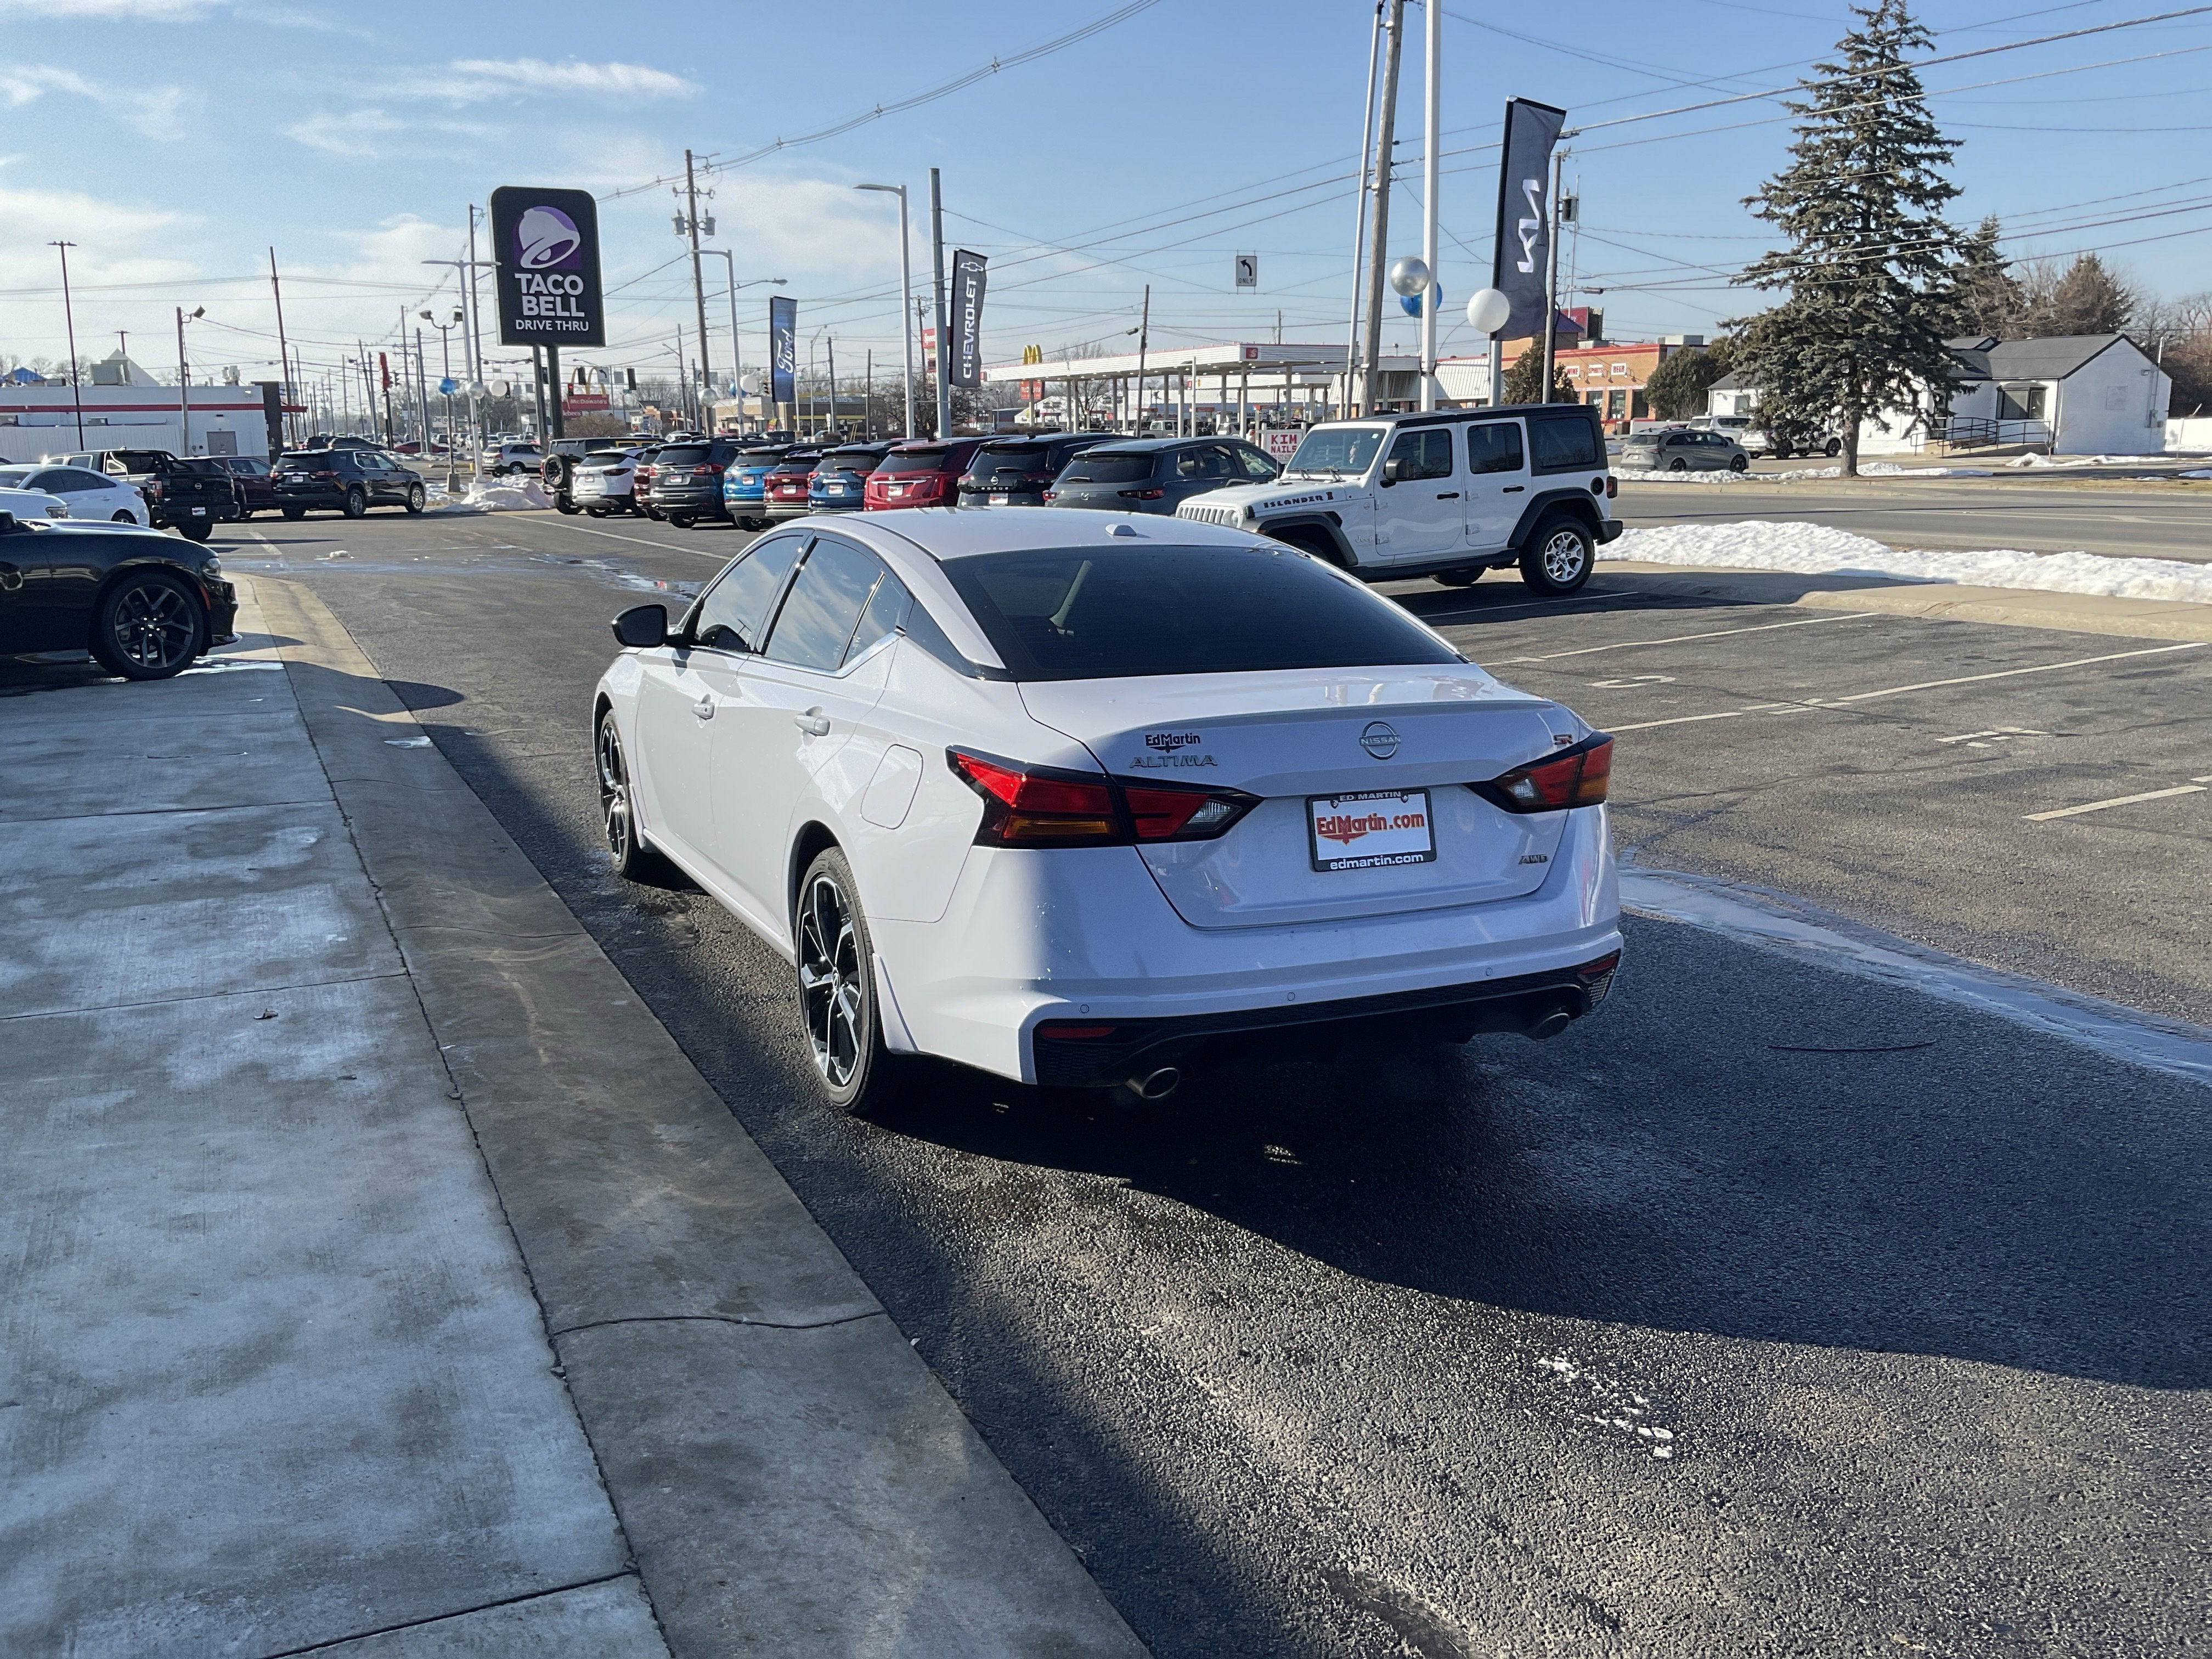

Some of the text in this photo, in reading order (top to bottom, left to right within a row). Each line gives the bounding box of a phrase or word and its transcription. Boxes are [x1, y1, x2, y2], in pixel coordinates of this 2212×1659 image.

[514, 273, 584, 296] TACO
[522, 295, 585, 317] BELL
[515, 319, 589, 331] DRIVE THRU
[963, 276, 977, 379] CHEVROLET
[776, 328, 794, 374] Ford
[1271, 434, 1297, 444] KIM
[1271, 445, 1297, 454] NAILS
[1263, 494, 1324, 508] ISLANDER
[1355, 535, 1374, 544] Jeep
[1361, 736, 1401, 744] NISSAN
[1554, 733, 1573, 745] SR
[1129, 754, 1218, 769] ALTIMA
[1358, 791, 1401, 800] MARTIN
[1316, 812, 1425, 836] EdMartin.com
[1330, 854, 1424, 870] edmartin.com
